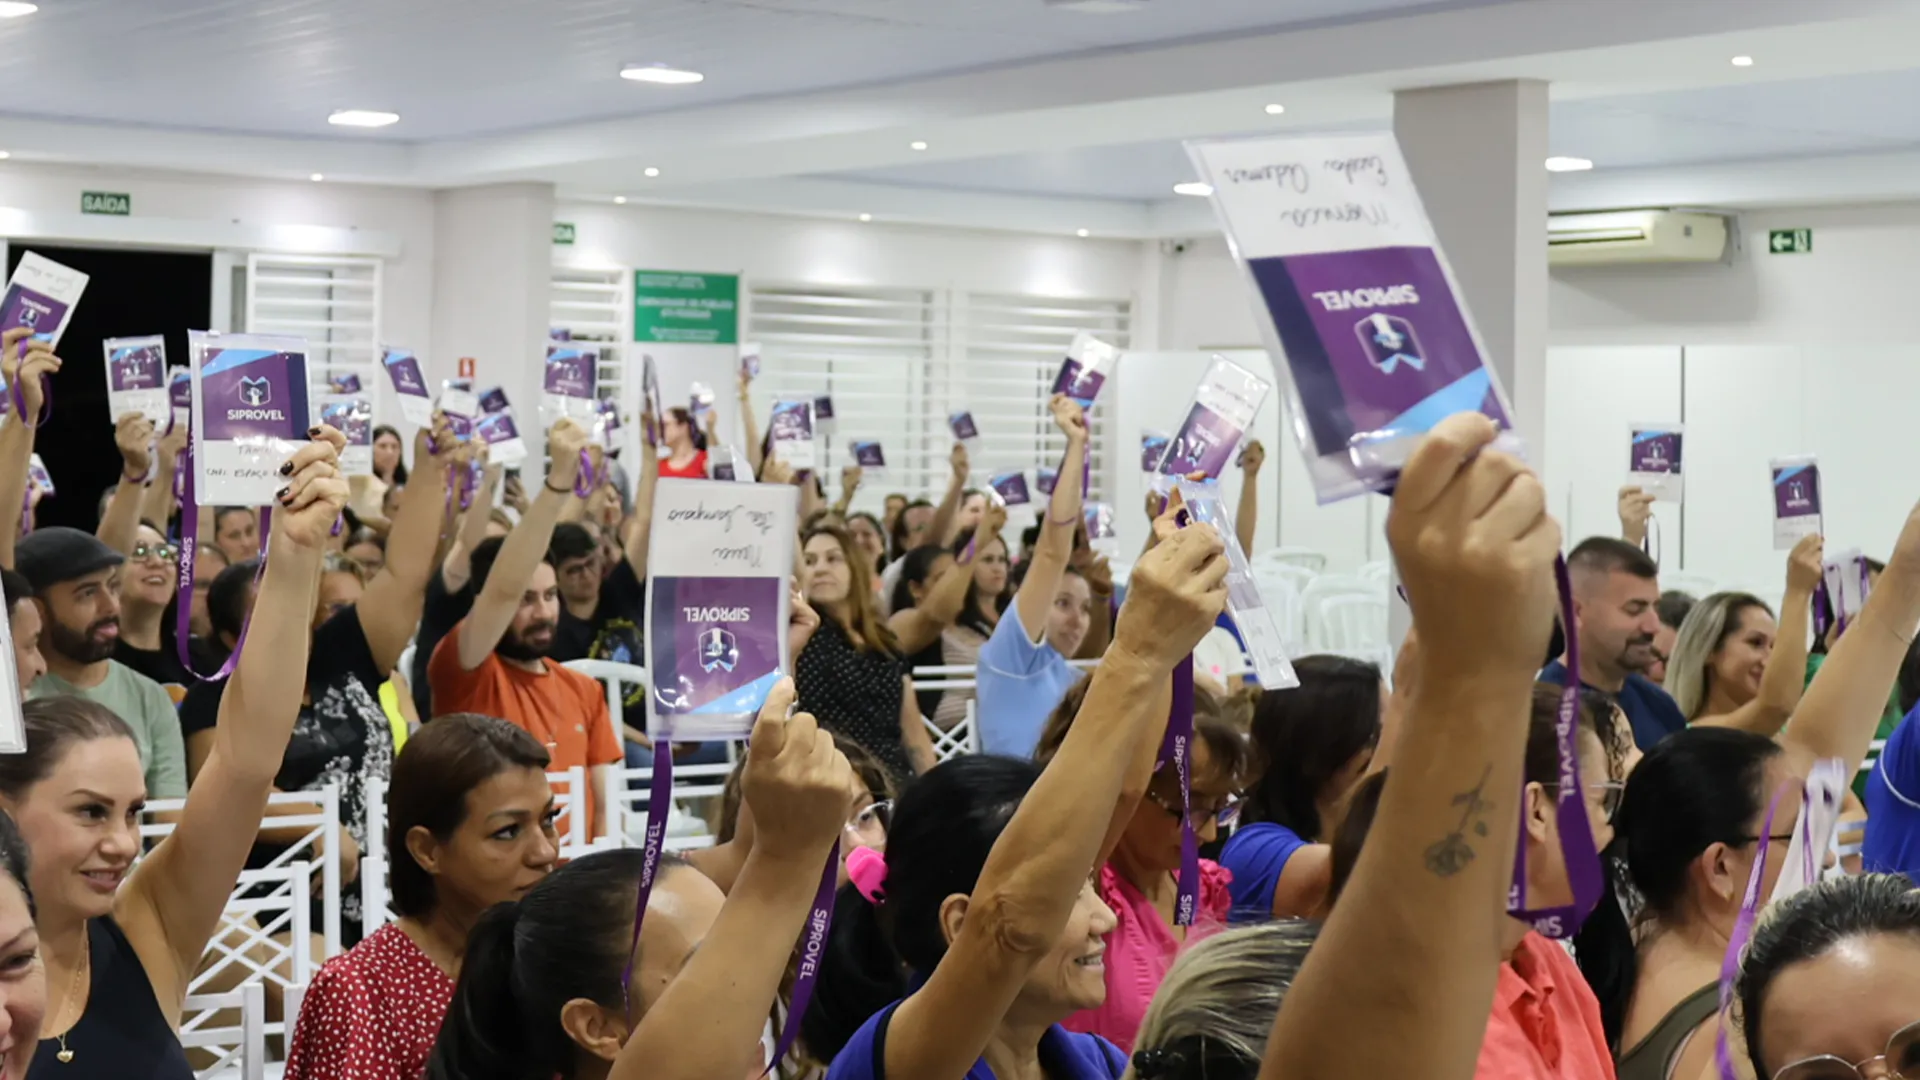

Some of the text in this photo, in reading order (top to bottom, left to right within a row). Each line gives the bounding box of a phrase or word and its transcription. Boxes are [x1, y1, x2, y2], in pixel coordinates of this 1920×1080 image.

[84, 192, 128, 211] SAÍDA
[1312, 284, 1420, 310] SIPROVEL
[227, 408, 285, 421] SIPROVEL
[181, 537, 193, 587] SIPROVEL
[683, 607, 751, 622] SIPROVEL
[641, 821, 662, 888] SIPROVEL
[799, 908, 828, 981] SIPROVEL
